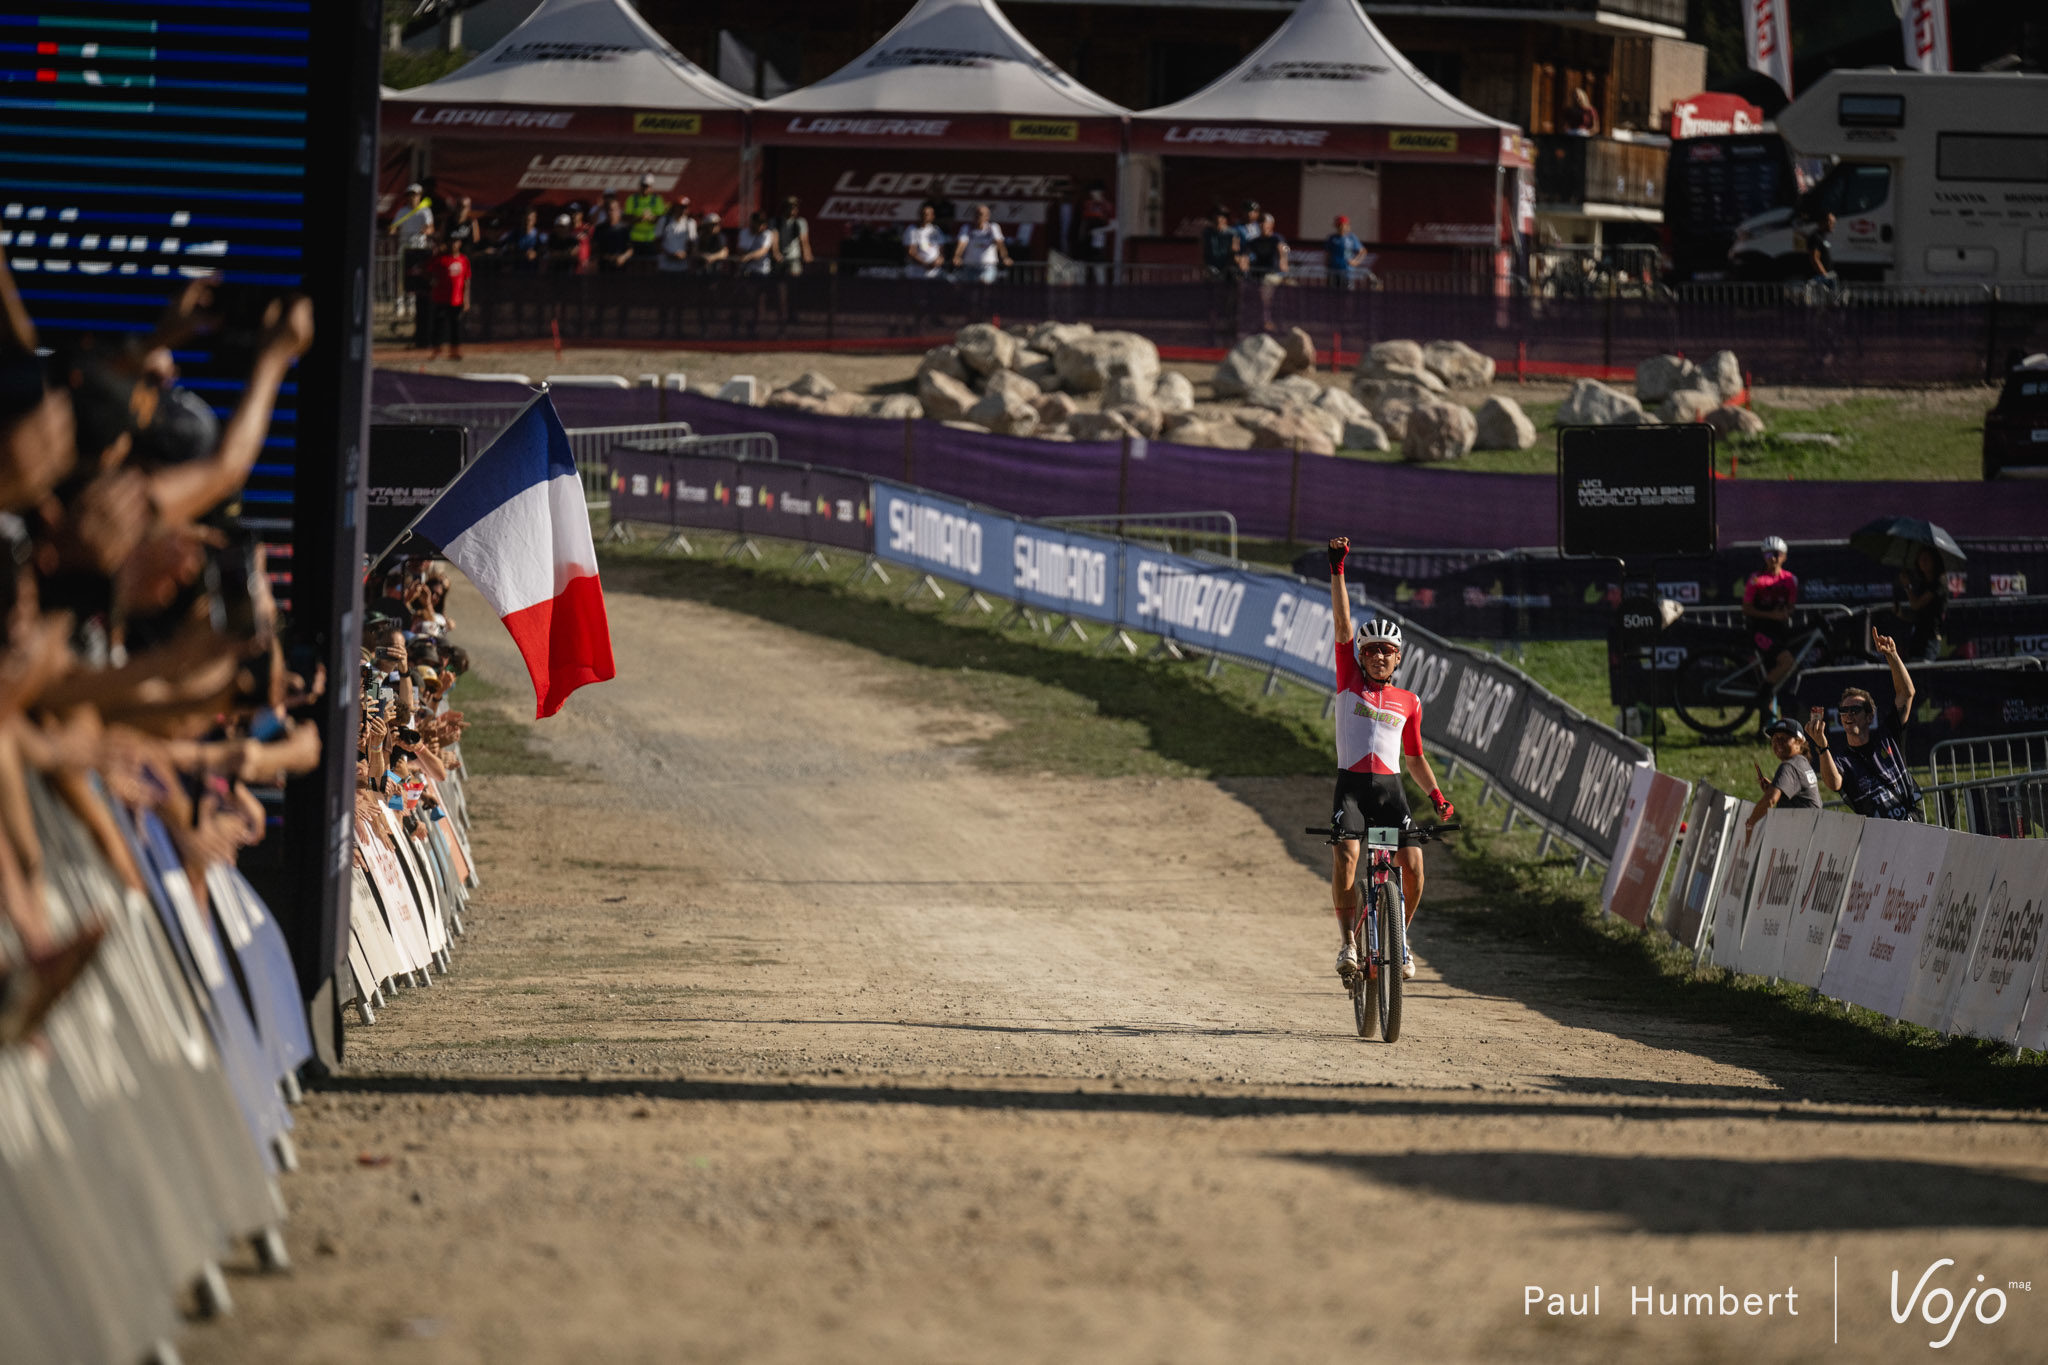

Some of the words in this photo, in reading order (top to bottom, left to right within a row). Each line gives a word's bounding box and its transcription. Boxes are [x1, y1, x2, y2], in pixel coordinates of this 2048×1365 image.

[411, 107, 575, 129] LAPIERRE
[786, 117, 952, 136] LAPIERRE
[1164, 126, 1330, 146] LAPIERRE
[526, 154, 691, 174] LAPIERRE
[1578, 487, 1657, 497] MOUNTAIN
[1660, 486, 1696, 496] BIKE
[1578, 496, 1637, 506] WORLD
[889, 498, 983, 576] SHIMANO
[1013, 535, 1106, 606] SHIMANO
[1137, 560, 1247, 637] SHIMANO
[1264, 592, 1340, 672] SHIMA
[1623, 614, 1654, 628] 50m
[1353, 702, 1402, 728] TRINITY
[1511, 707, 1577, 802] WHOOP
[1571, 741, 1634, 838] WHOOP
[1379, 830, 1387, 842] 1
